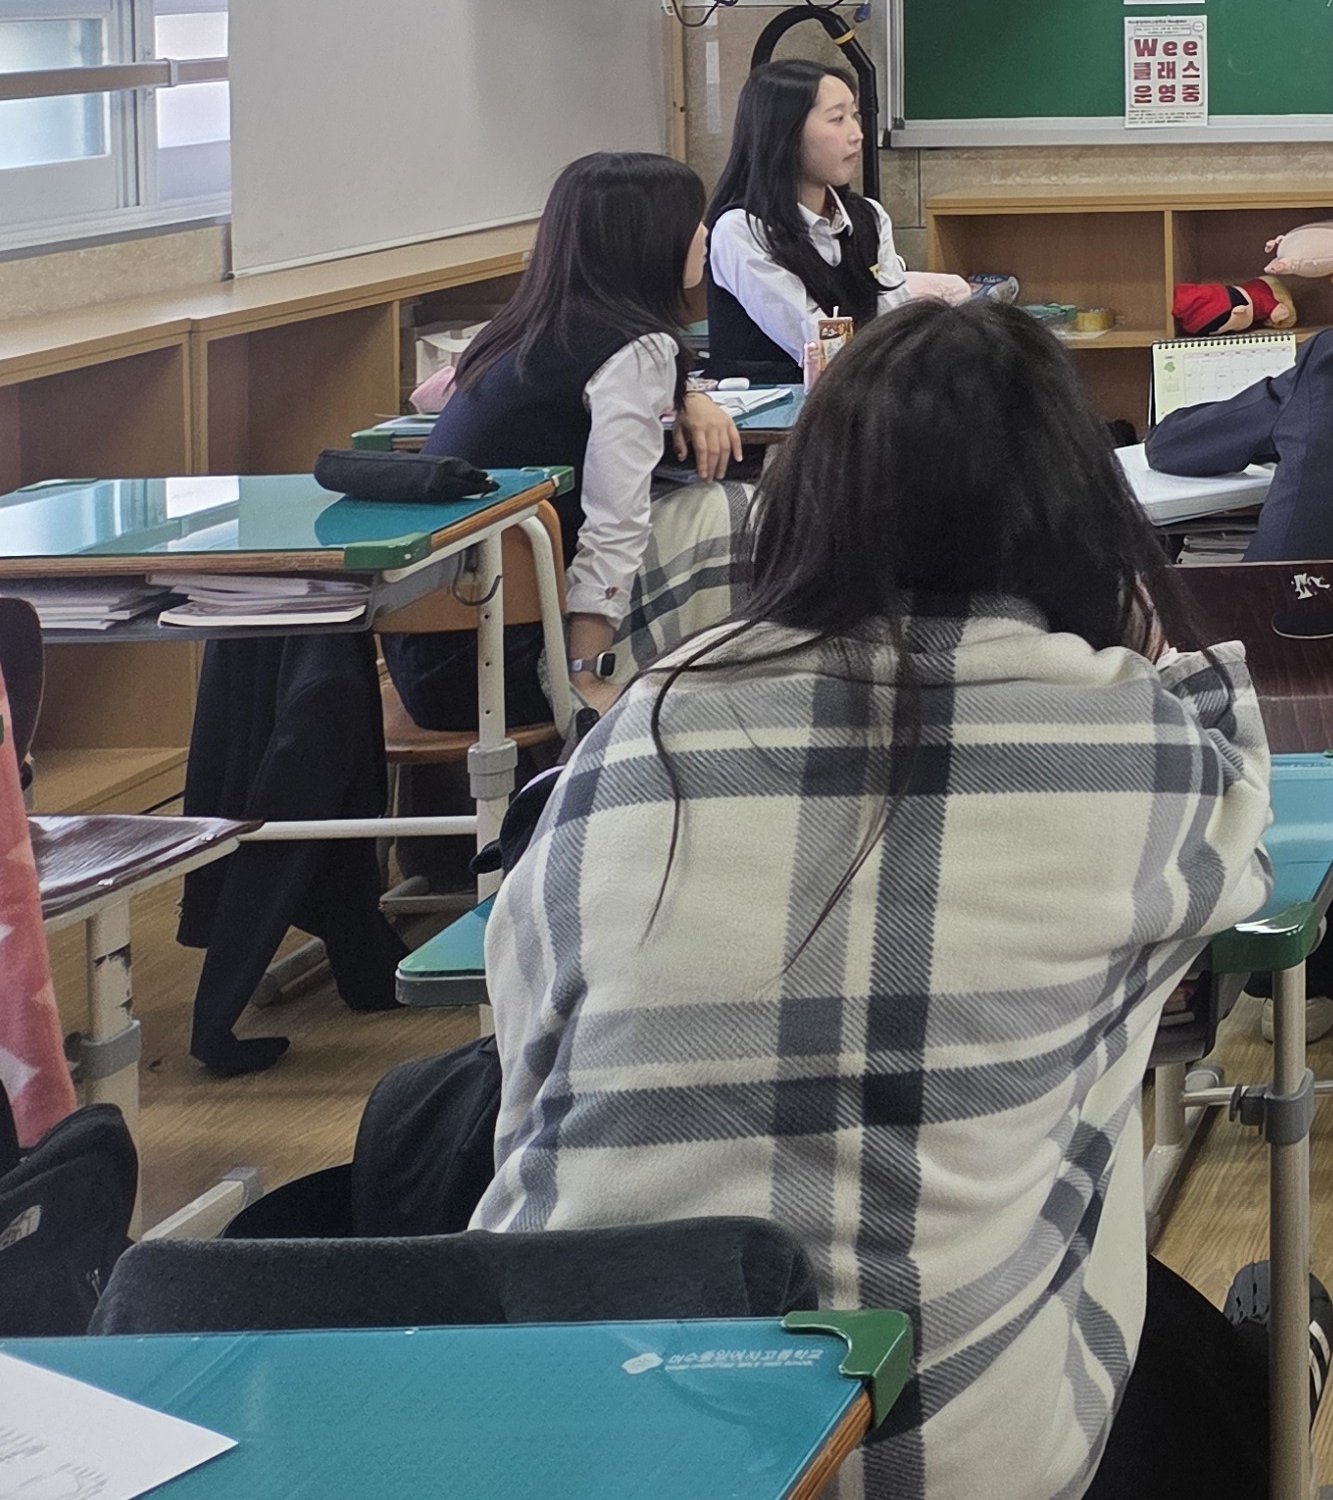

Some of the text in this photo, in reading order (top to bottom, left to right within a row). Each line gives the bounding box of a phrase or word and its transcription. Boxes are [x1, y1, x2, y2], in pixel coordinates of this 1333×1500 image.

[1134, 38, 1198, 57] Wee
[1133, 61, 1200, 80] 클래스
[1134, 84, 1200, 104] 운영중
